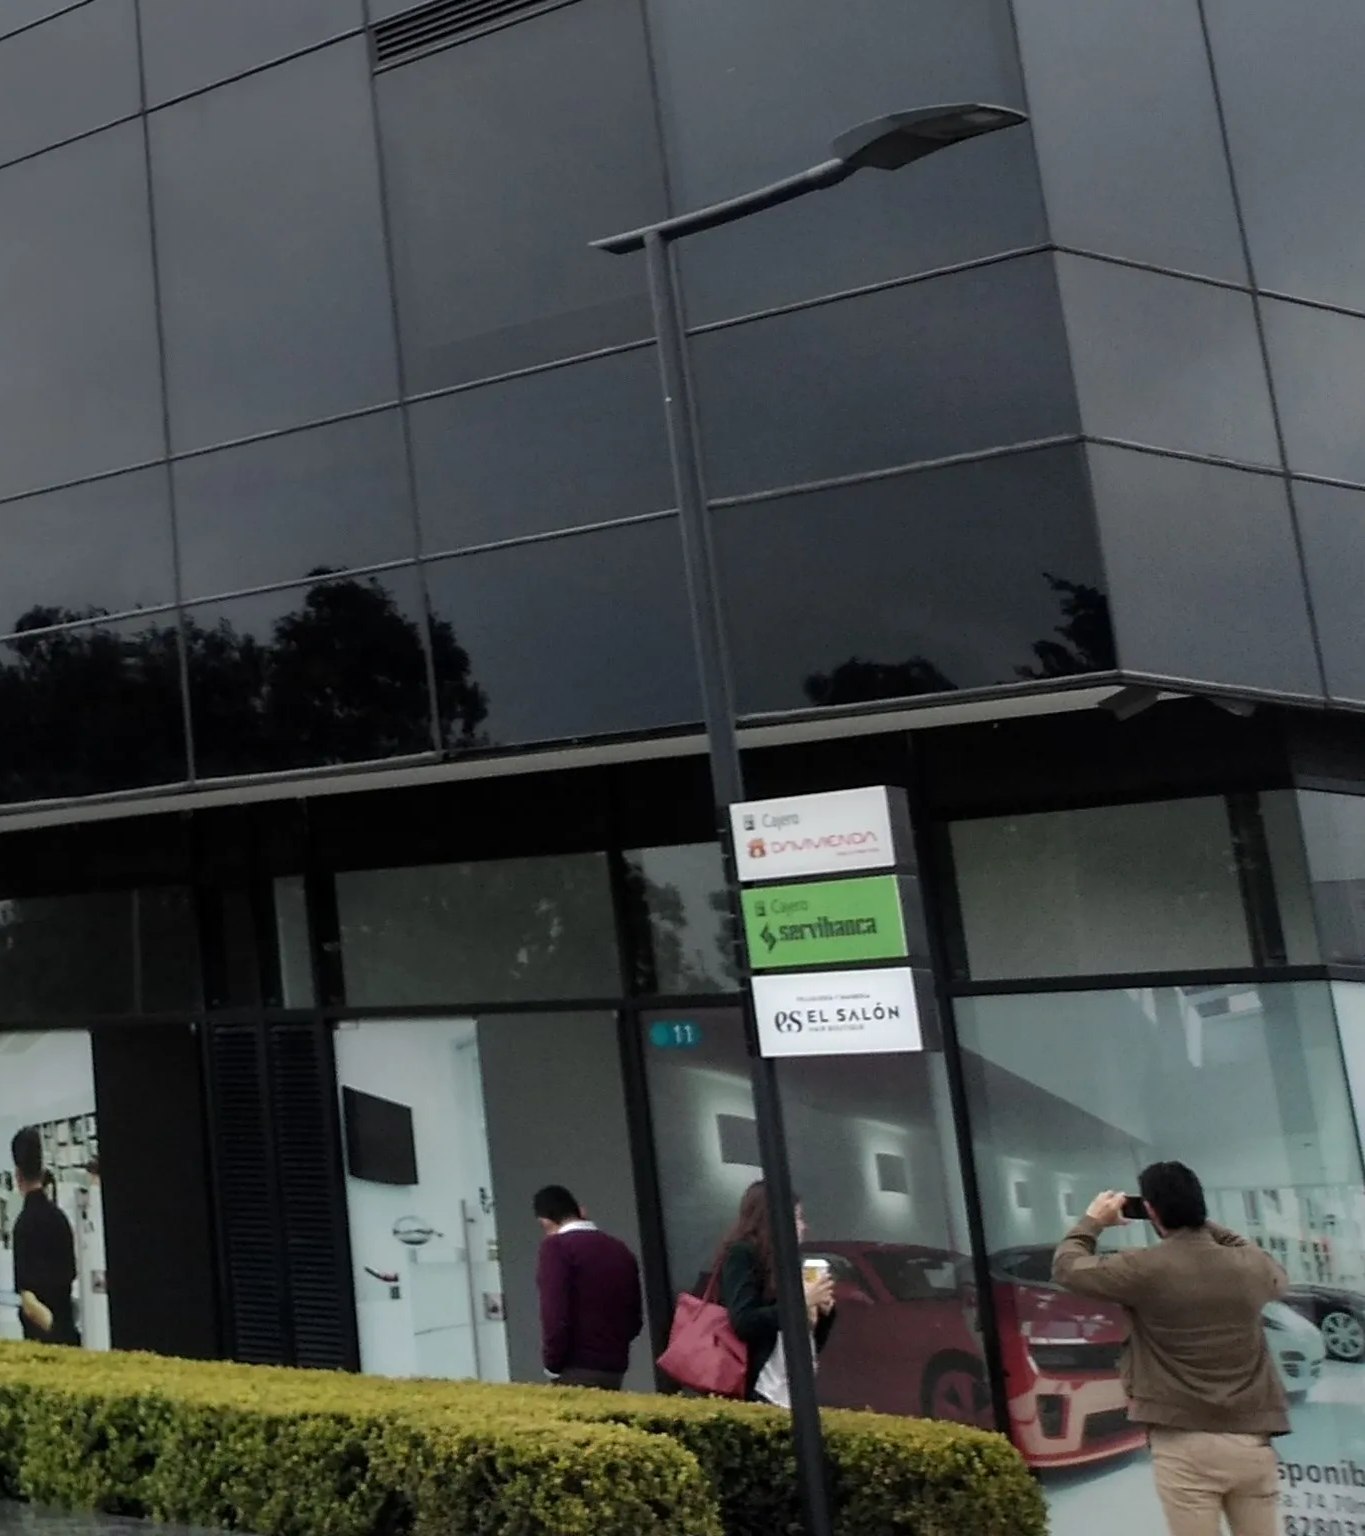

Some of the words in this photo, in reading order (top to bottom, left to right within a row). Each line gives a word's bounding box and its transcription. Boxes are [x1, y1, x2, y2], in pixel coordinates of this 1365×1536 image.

[761, 813, 800, 830] Cajero
[770, 898, 809, 917] Cajero
[778, 915, 878, 942] servibanca
[807, 1009, 829, 1023] EL
[836, 1002, 900, 1023] SALÓN
[673, 1024, 693, 1043] 11
